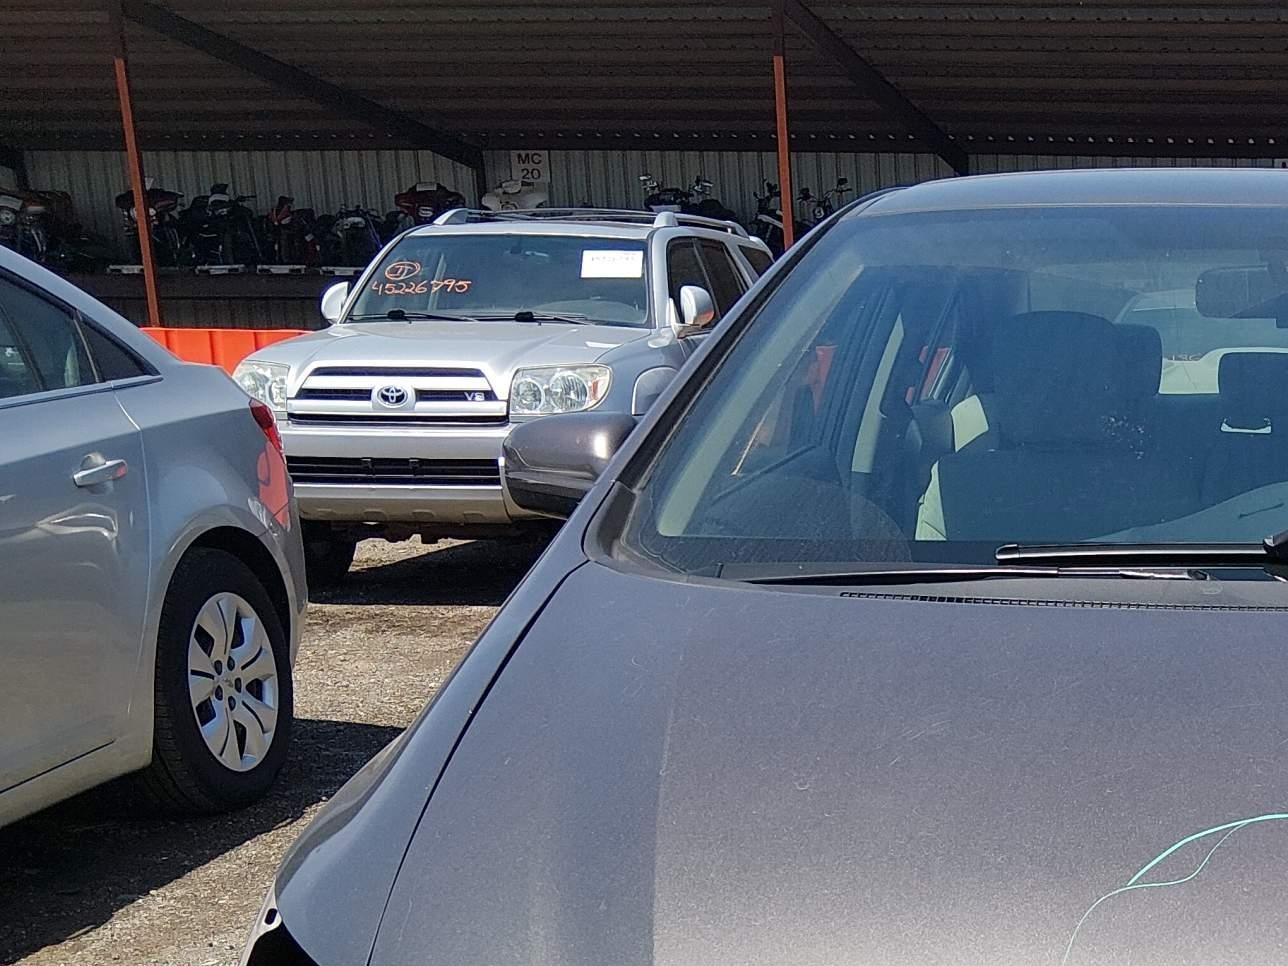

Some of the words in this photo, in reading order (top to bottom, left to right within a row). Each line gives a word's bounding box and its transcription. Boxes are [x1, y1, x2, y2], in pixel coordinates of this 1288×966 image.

[517, 153, 542, 165] MC
[520, 168, 541, 180] 20
[371, 279, 472, 295] 45226795
[464, 391, 485, 402] V8
